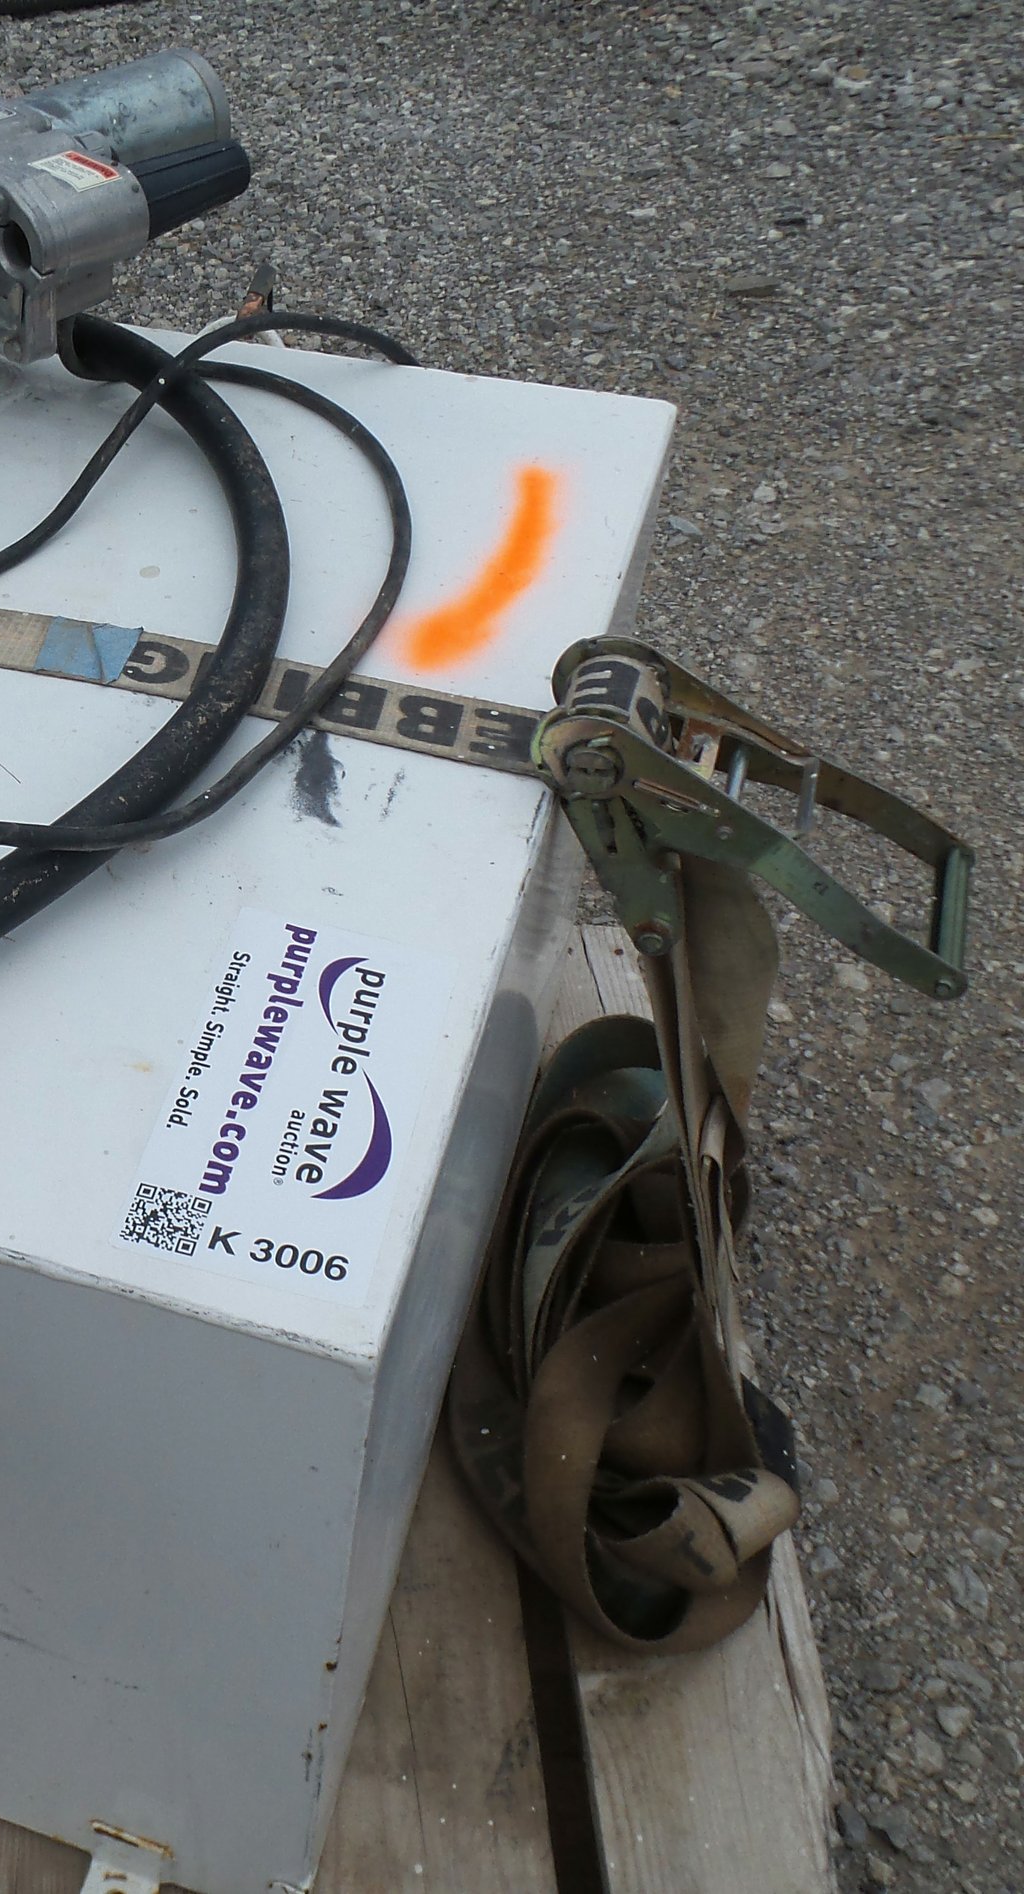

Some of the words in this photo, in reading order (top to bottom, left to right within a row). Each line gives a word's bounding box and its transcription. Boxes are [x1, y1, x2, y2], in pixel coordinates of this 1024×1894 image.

[210, 950, 251, 1016] Straight.
[185, 1019, 225, 1080] Simple.
[331, 966, 386, 1076] purple
[199, 923, 318, 1195] purplewave.com
[166, 1086, 199, 1128] Sold.
[295, 1088, 349, 1185] wave
[208, 1226, 242, 1255] K
[249, 1238, 350, 1281] 3006
